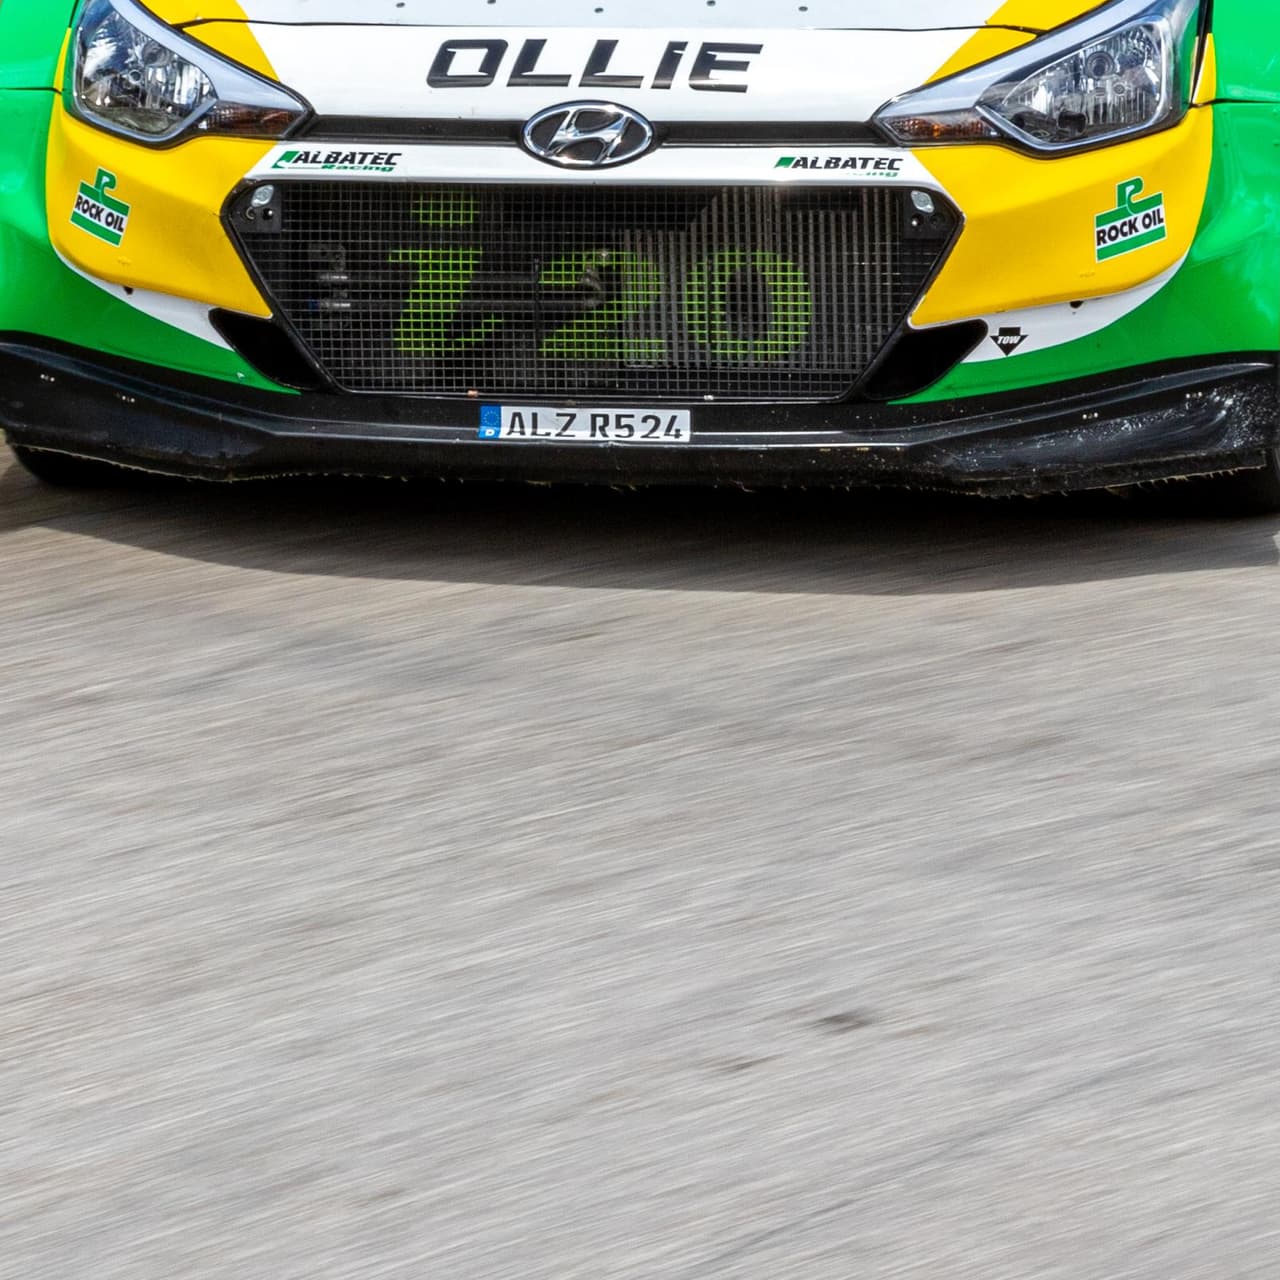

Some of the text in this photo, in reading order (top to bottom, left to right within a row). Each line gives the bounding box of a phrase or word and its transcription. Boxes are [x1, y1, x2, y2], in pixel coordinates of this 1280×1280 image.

[426, 38, 764, 94] OLLIE
[291, 151, 402, 166] ALBATEC
[320, 164, 395, 173] Racing
[791, 156, 904, 171] ALBATEC
[74, 194, 125, 233] ROCK OIL
[1096, 208, 1164, 246] ROCK OIL
[997, 335, 1021, 344] TOW
[506, 411, 577, 438] ALZ
[589, 413, 683, 439] R524
